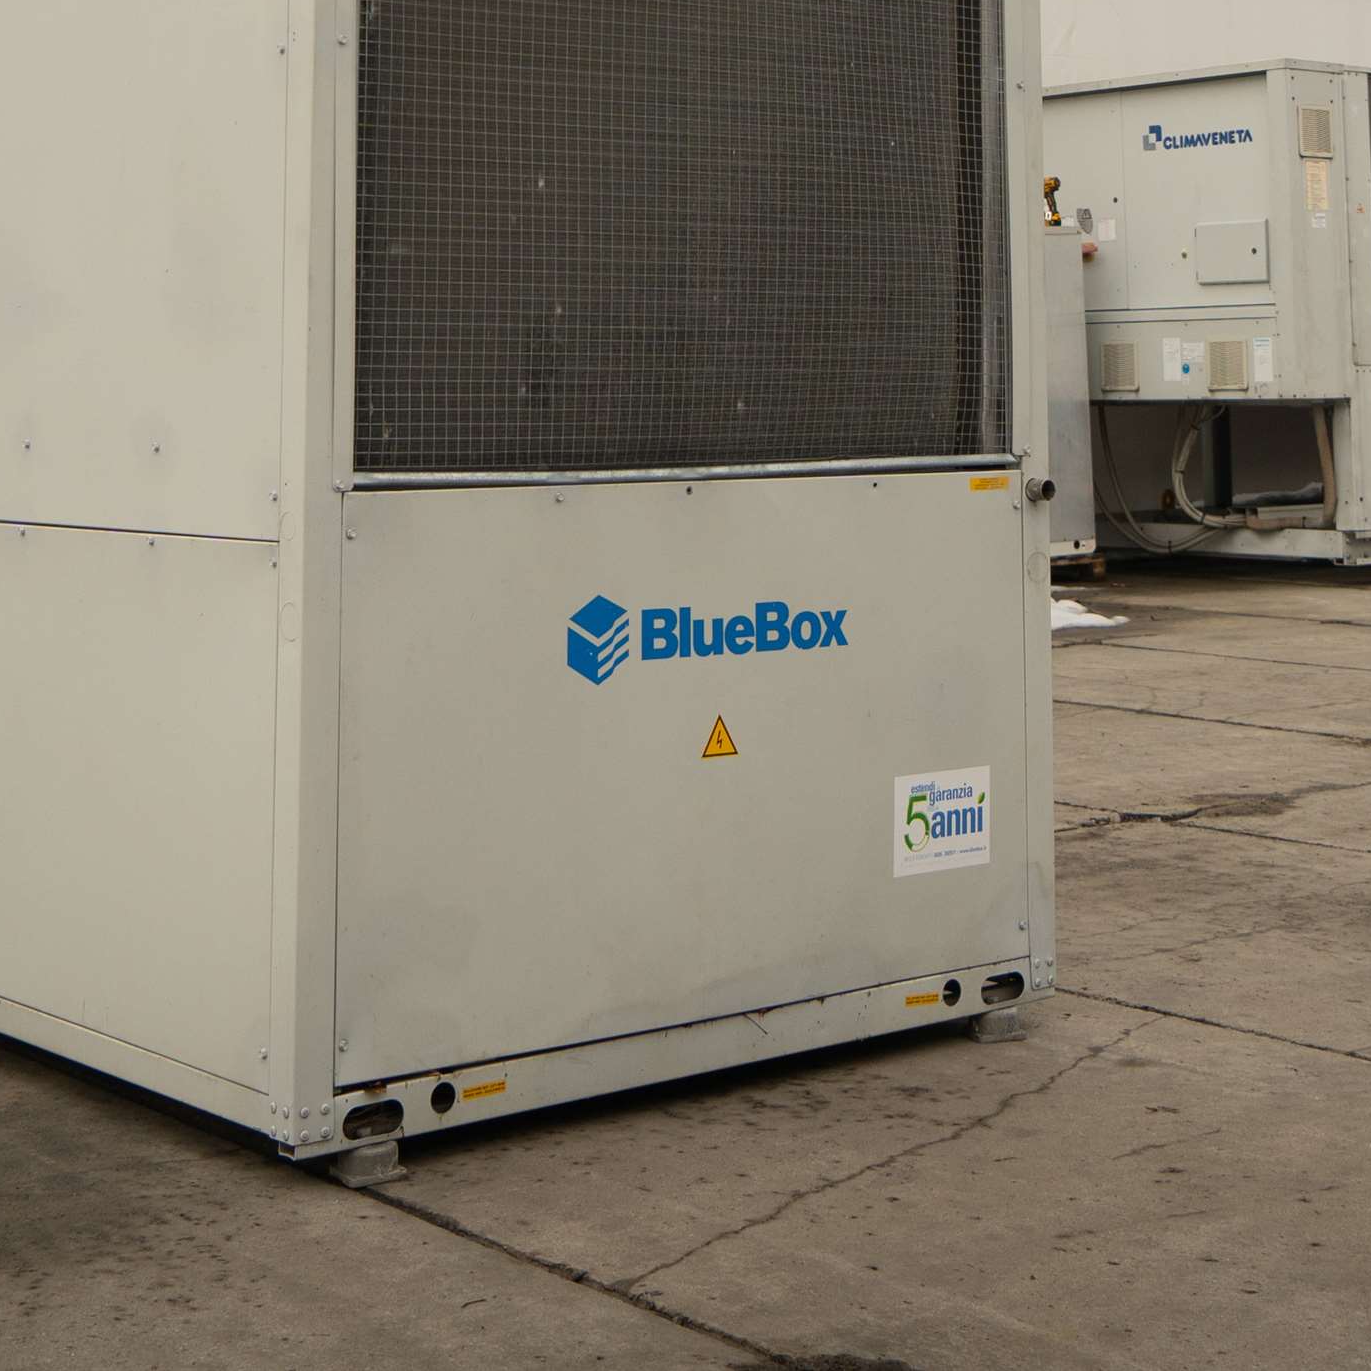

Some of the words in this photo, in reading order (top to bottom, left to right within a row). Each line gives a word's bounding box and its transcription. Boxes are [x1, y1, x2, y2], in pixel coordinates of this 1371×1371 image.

[1163, 129, 1253, 150] CLIMAVENETA
[641, 601, 848, 660] BlueBox
[929, 782, 973, 806] garanzia
[904, 794, 930, 853] 5
[931, 792, 985, 839] anni
